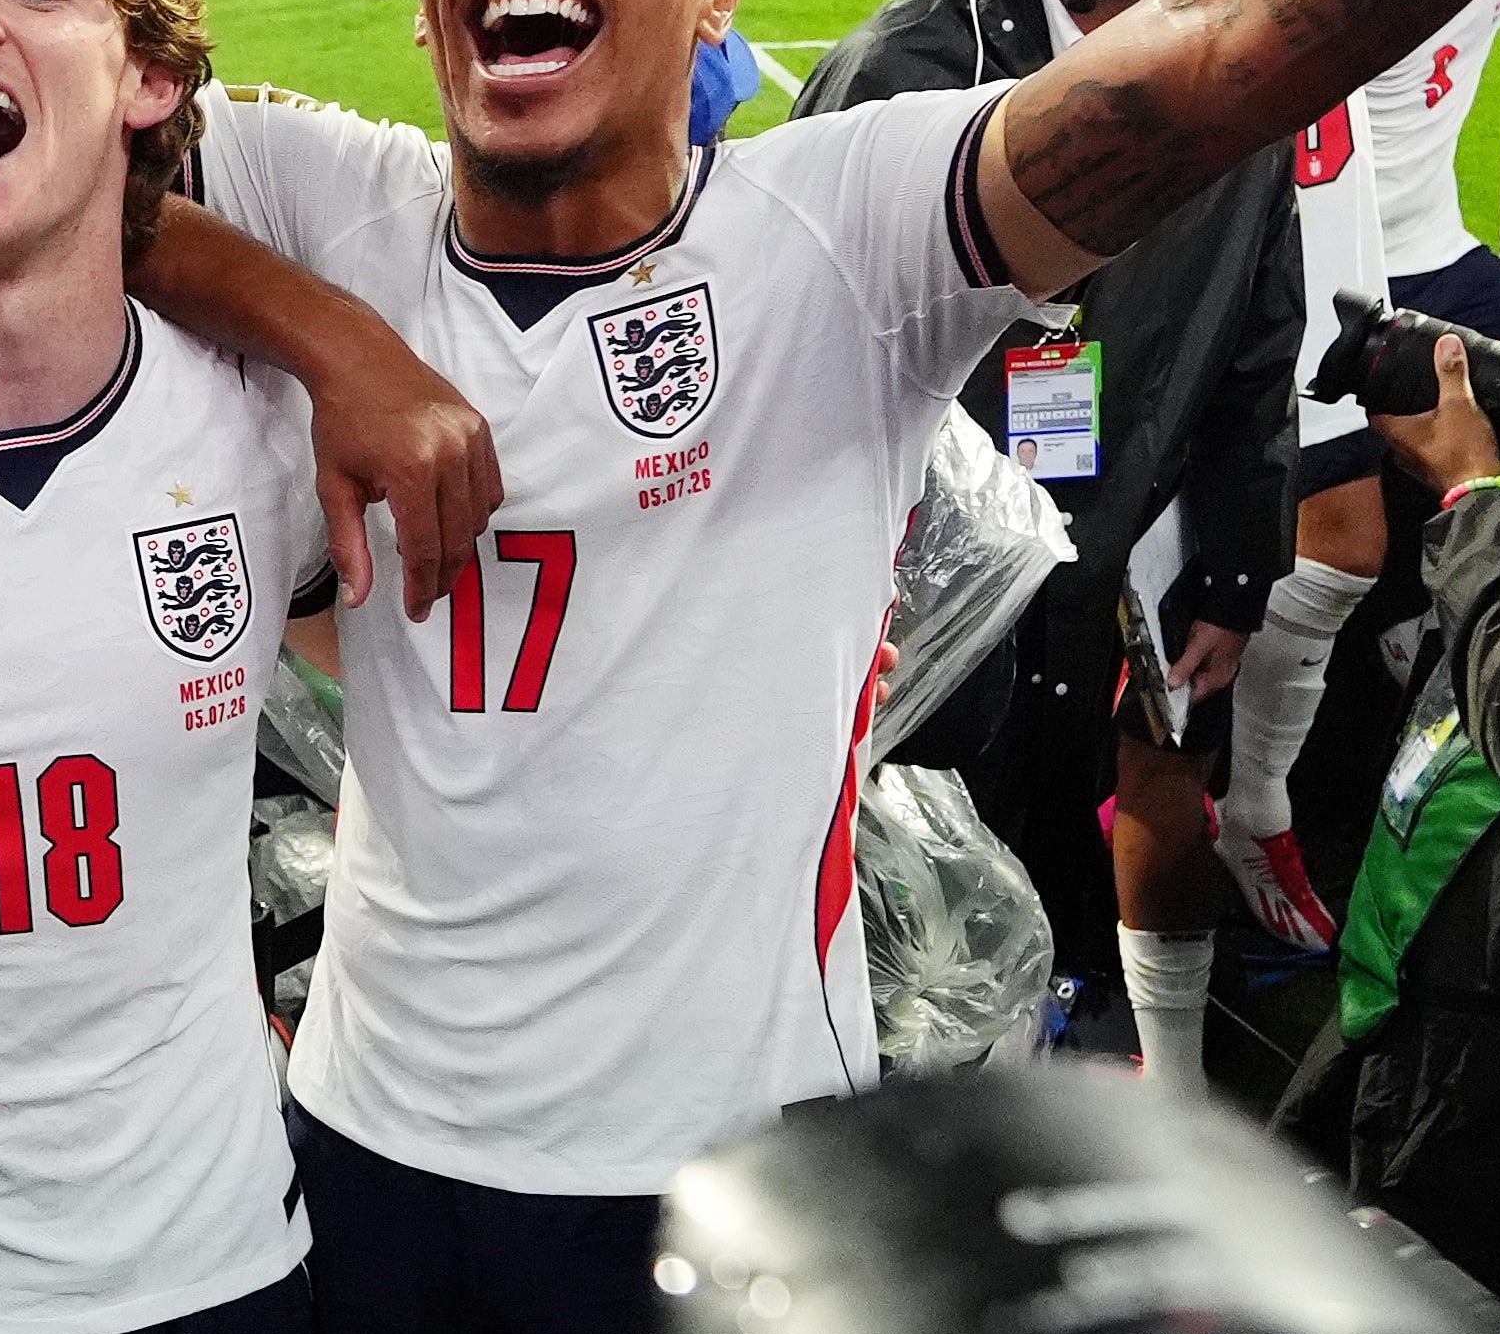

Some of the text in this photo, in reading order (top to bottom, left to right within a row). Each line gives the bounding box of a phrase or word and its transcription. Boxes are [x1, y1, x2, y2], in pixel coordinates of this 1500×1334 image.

[633, 439, 711, 481] MEXICO
[638, 467, 712, 511] 05.07.26
[448, 529, 579, 714] 17
[178, 665, 248, 705] MEXICO
[183, 694, 248, 733] 05.07.26
